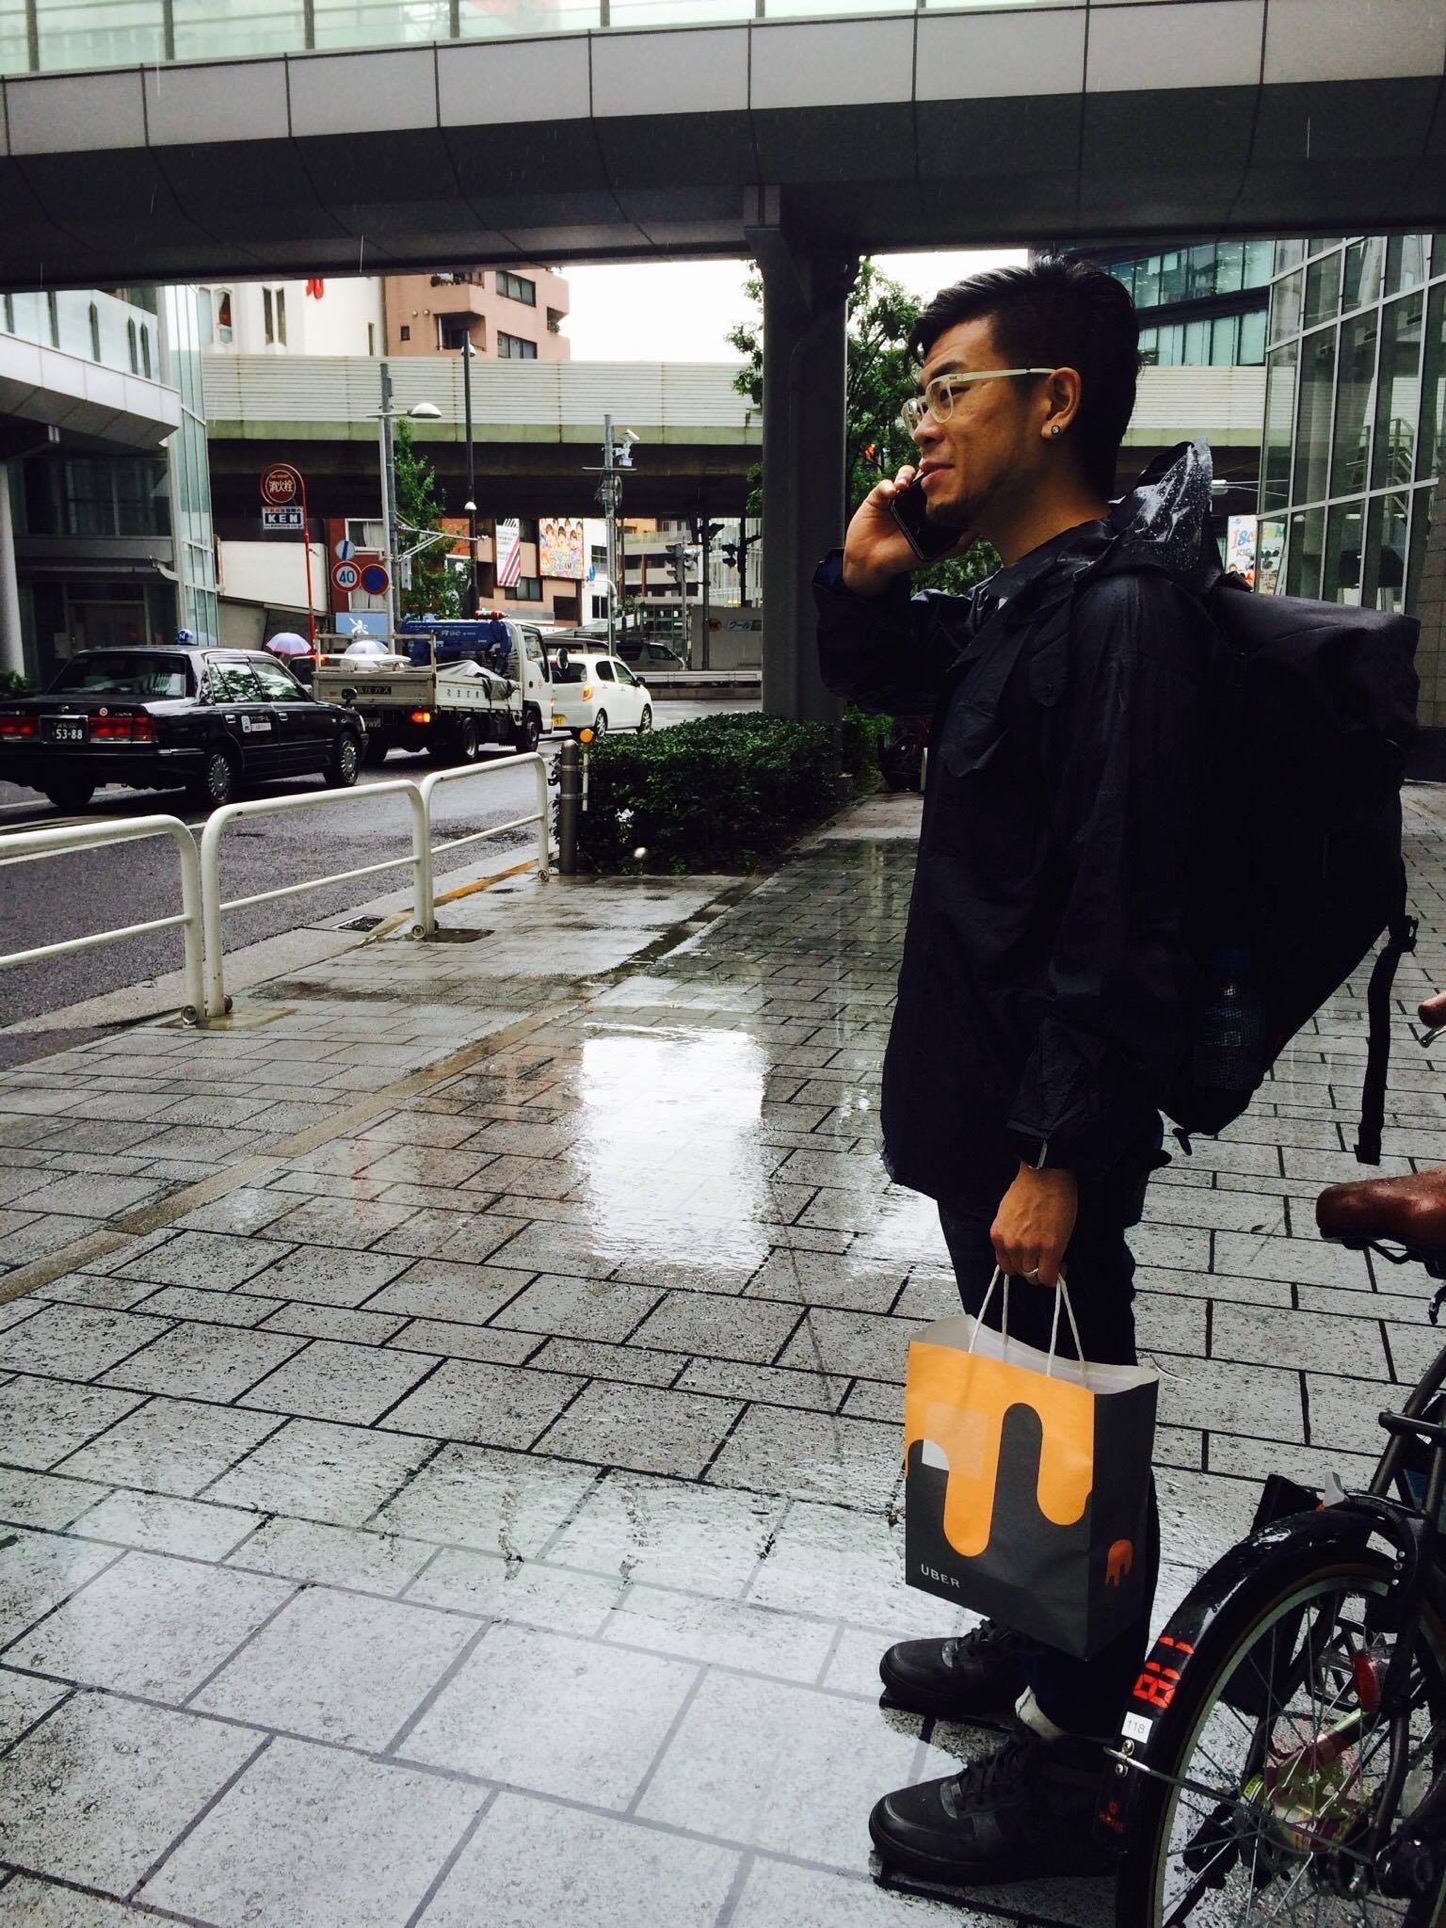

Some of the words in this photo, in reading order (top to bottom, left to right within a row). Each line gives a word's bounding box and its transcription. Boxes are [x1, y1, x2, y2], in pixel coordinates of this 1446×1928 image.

[268, 514, 298, 523] KEN
[339, 570, 355, 584] 40
[921, 1563, 960, 1588] UBER
